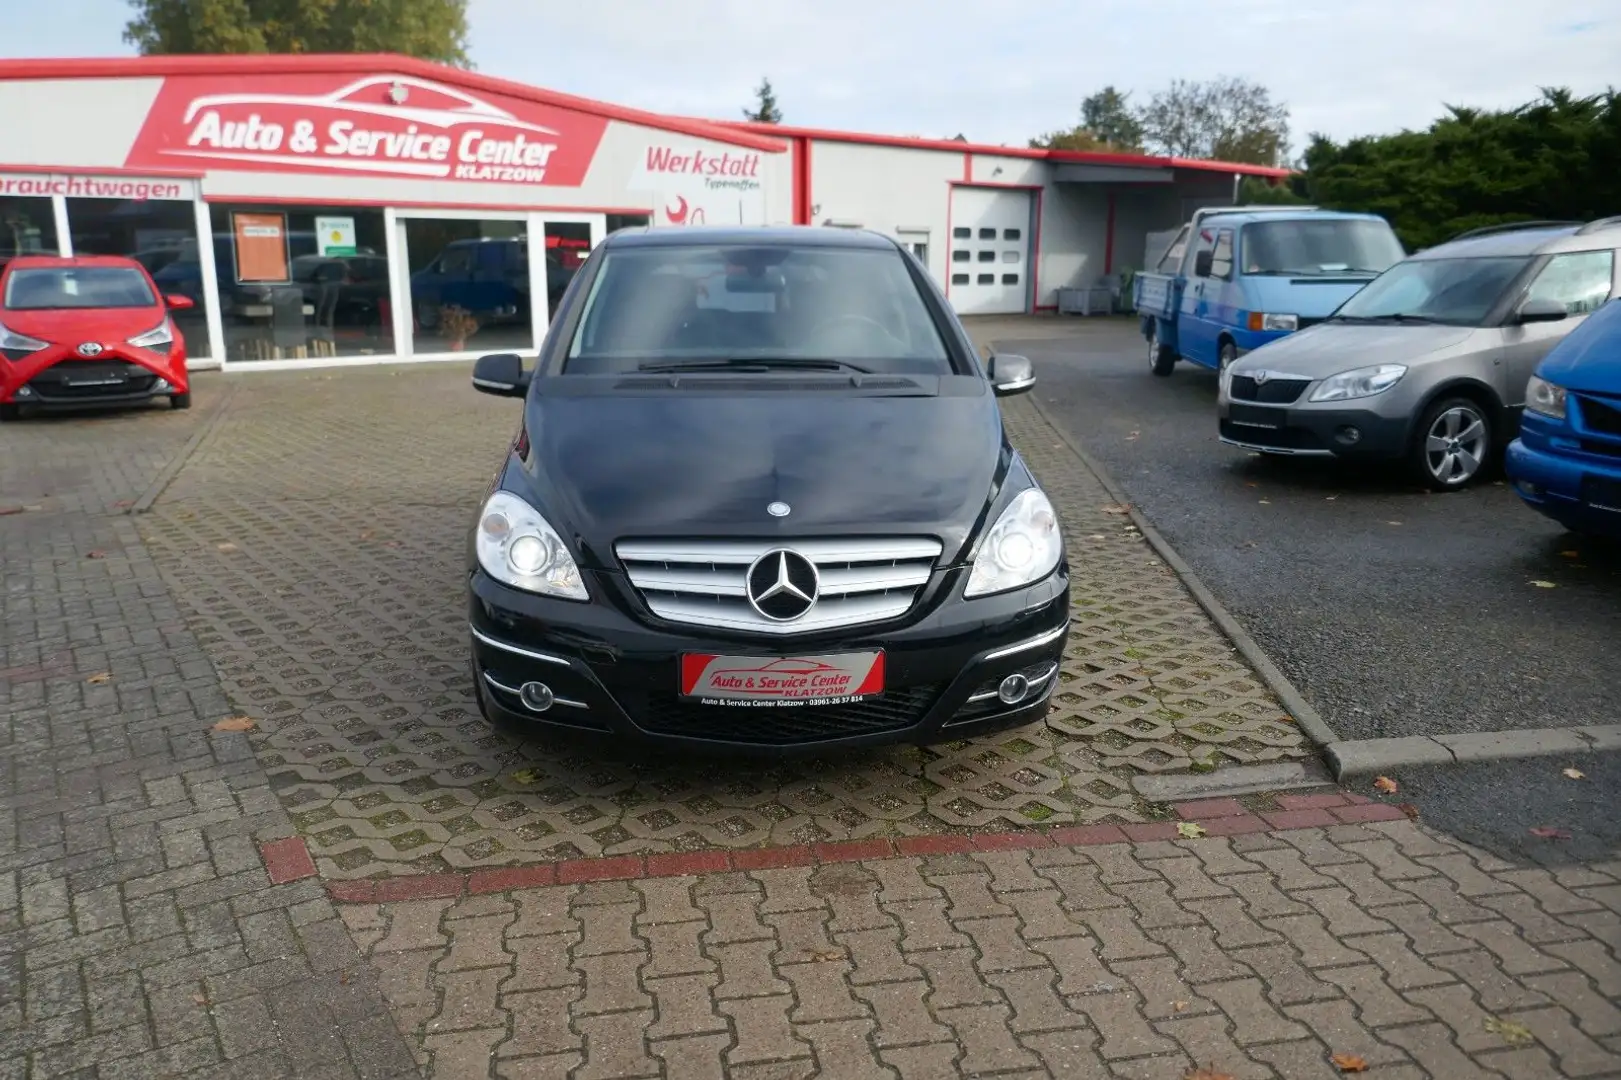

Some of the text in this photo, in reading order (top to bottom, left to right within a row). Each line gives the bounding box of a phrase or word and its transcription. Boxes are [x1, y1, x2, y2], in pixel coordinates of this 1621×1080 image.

[188, 111, 557, 167] Auto & Service Center
[646, 146, 759, 177] Werkstatt
[455, 163, 545, 183] KLATZOW
[711, 673, 852, 688] Auto & Service Center
[784, 686, 847, 697] KLATZOW
[809, 698, 840, 706] 03961-26
[841, 696, 850, 704] 37
